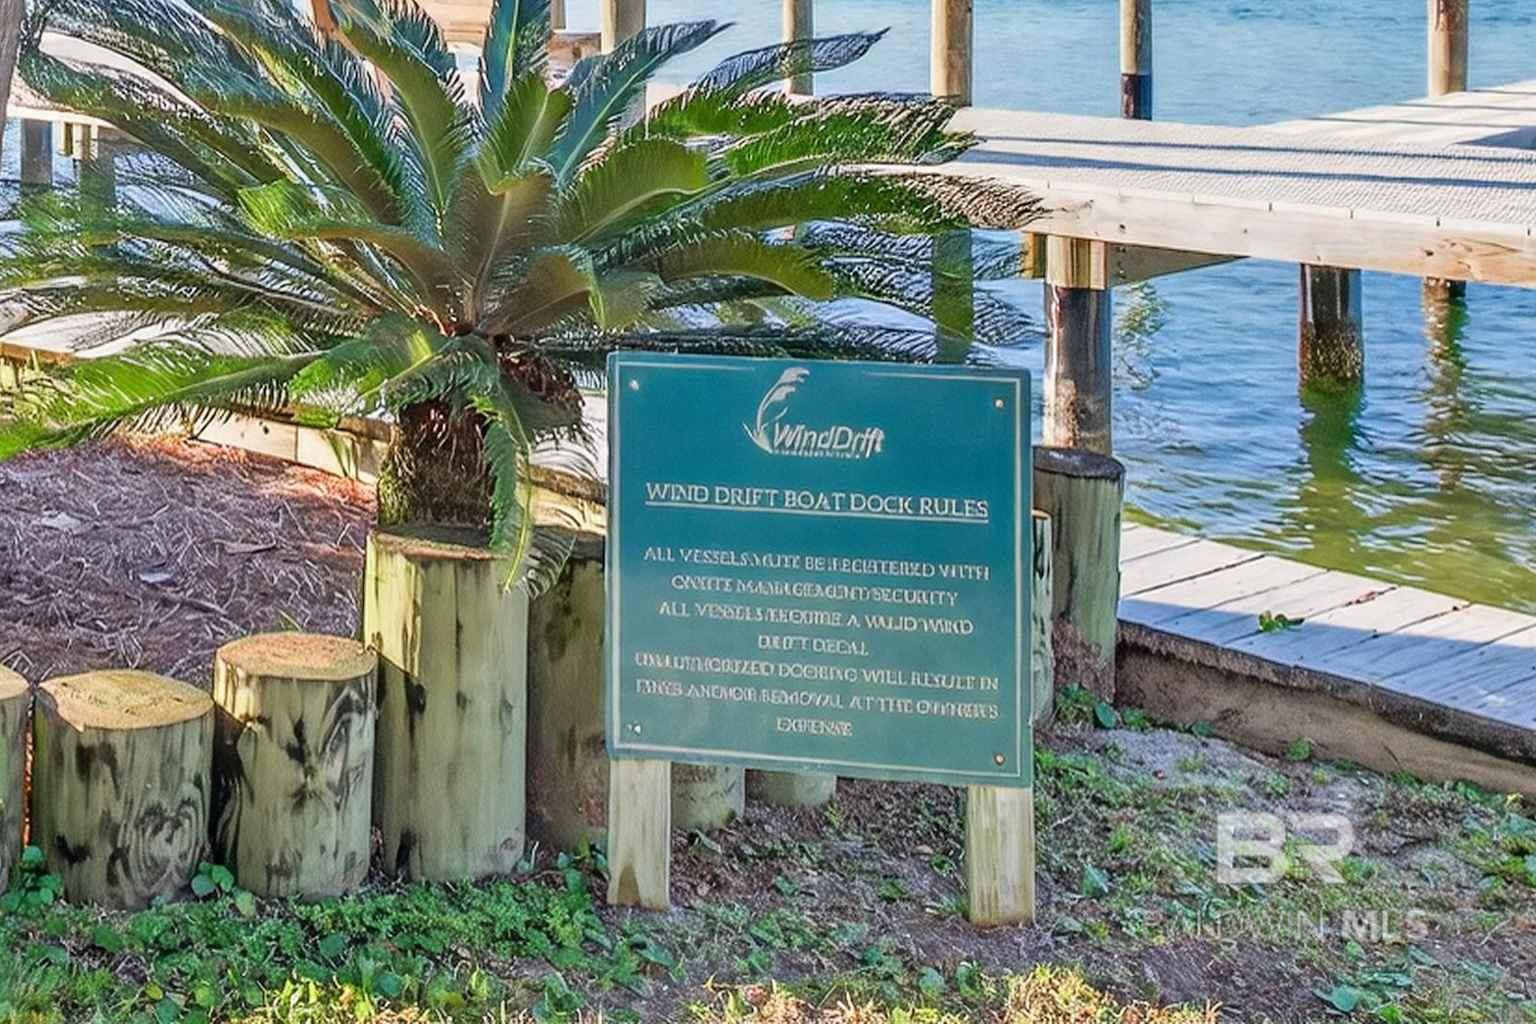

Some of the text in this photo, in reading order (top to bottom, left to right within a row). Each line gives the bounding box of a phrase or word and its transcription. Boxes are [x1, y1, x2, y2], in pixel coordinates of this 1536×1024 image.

[773, 422, 885, 458] WindDrift
[645, 482, 989, 518] WIND DRIFT BOAT DOCK RULES
[643, 547, 675, 562] ALL
[805, 556, 825, 571] BE
[939, 564, 990, 581] WITH
[659, 601, 690, 617] ALL
[846, 613, 861, 628] A
[862, 668, 907, 686] WILL
